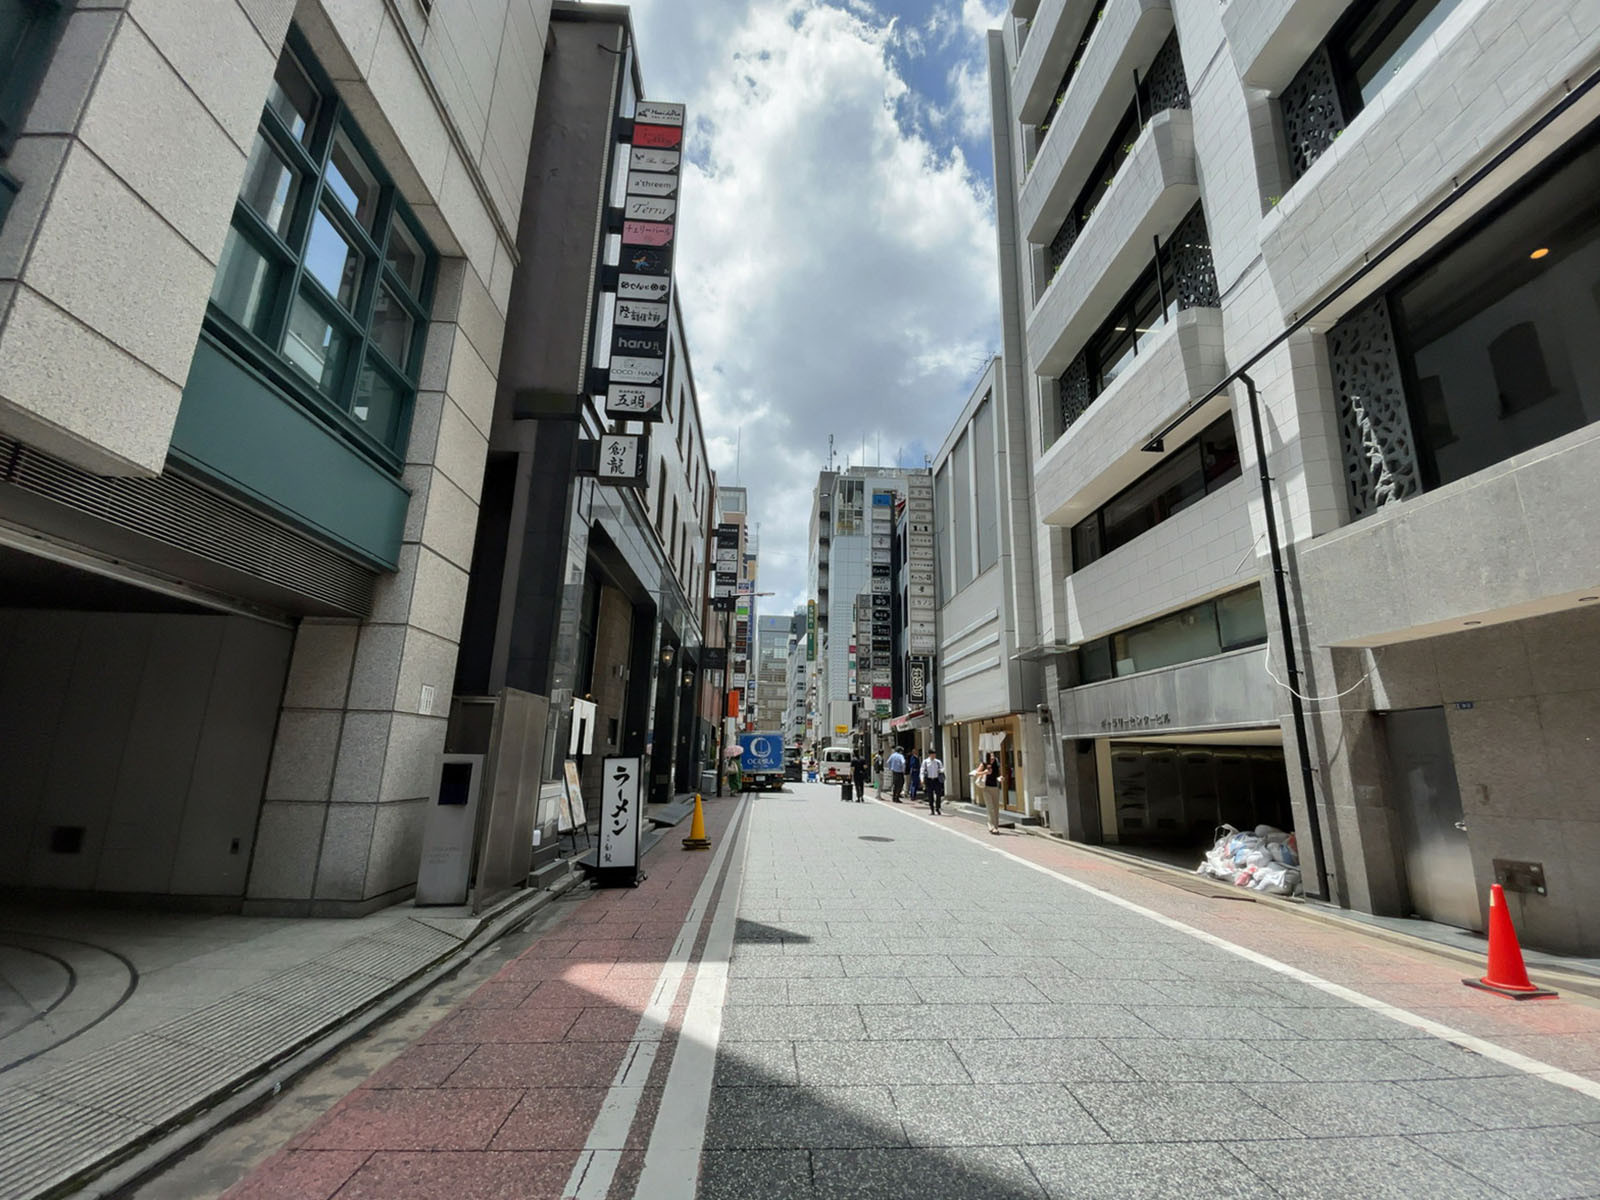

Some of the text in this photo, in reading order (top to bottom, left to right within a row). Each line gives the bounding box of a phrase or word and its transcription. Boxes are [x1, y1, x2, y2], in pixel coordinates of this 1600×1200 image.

[618, 337, 652, 349] haru
[611, 765, 631, 836] ラーメン
